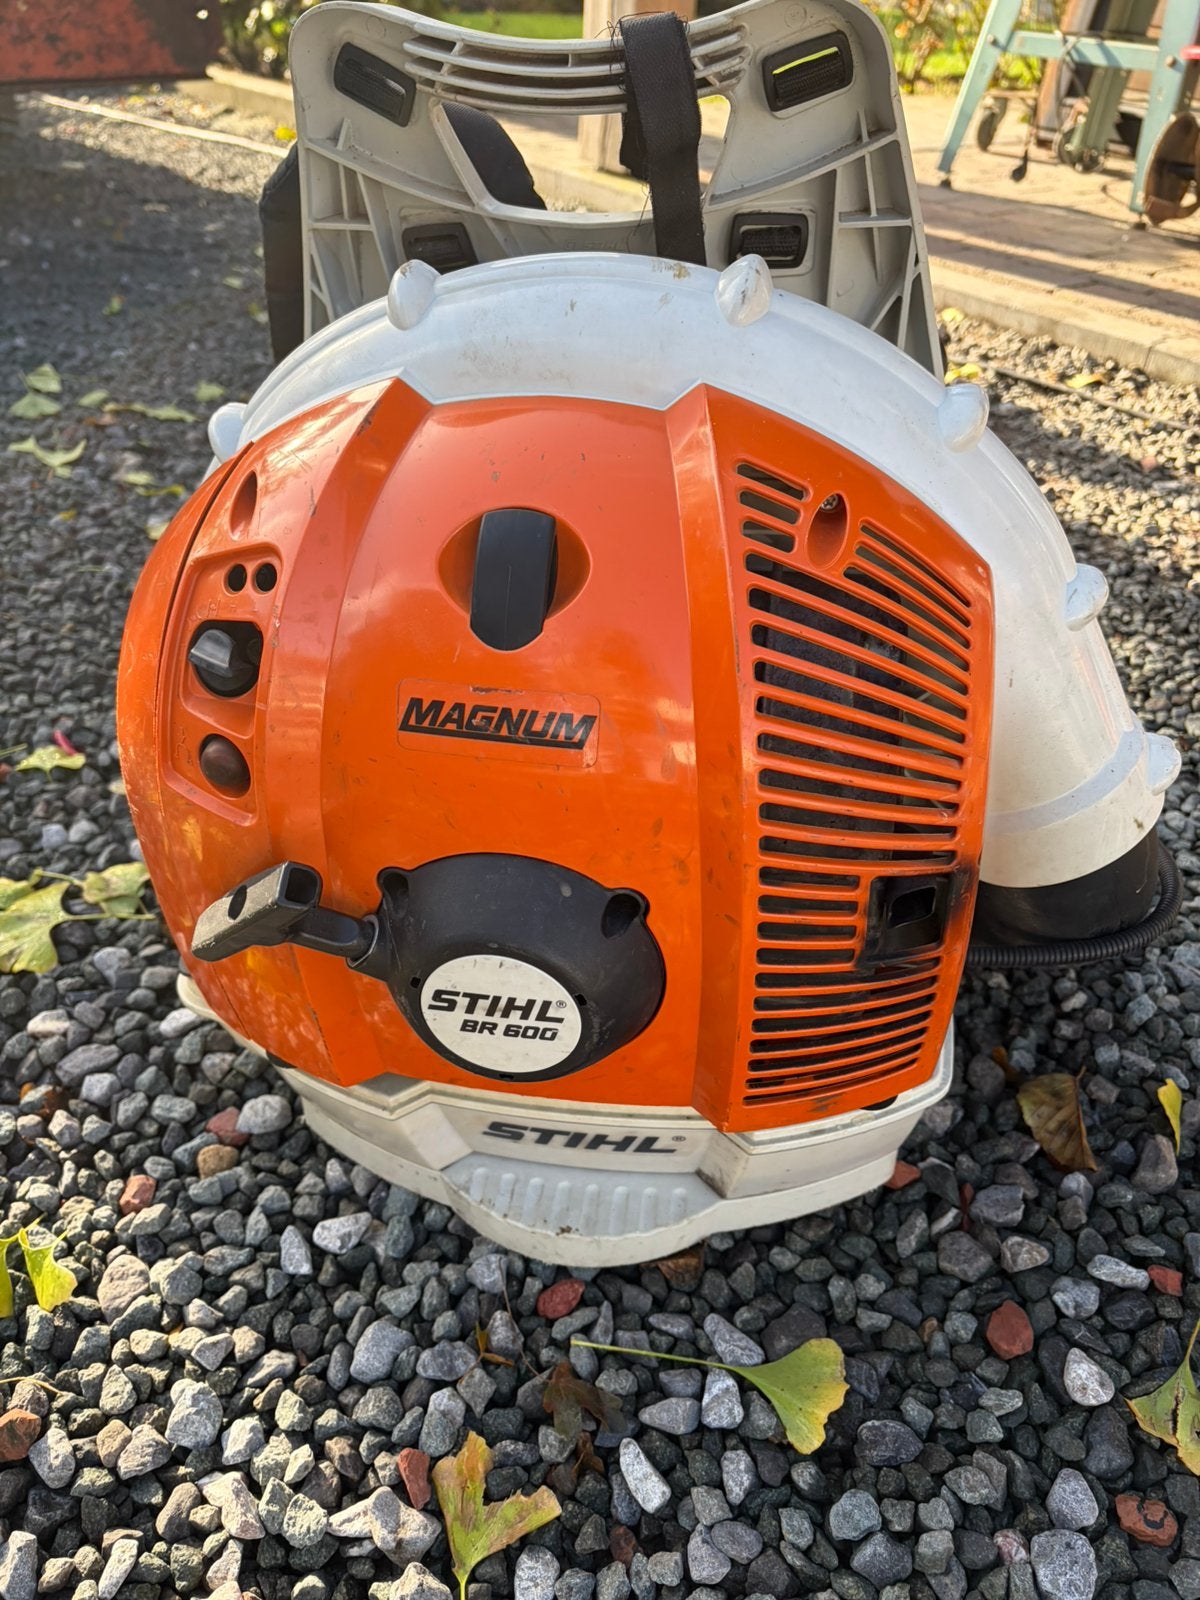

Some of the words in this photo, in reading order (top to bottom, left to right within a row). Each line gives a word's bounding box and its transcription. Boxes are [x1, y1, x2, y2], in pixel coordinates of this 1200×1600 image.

[399, 697, 597, 749] MAGNUM
[460, 1019, 498, 1035] BR
[503, 1024, 559, 1041] 600
